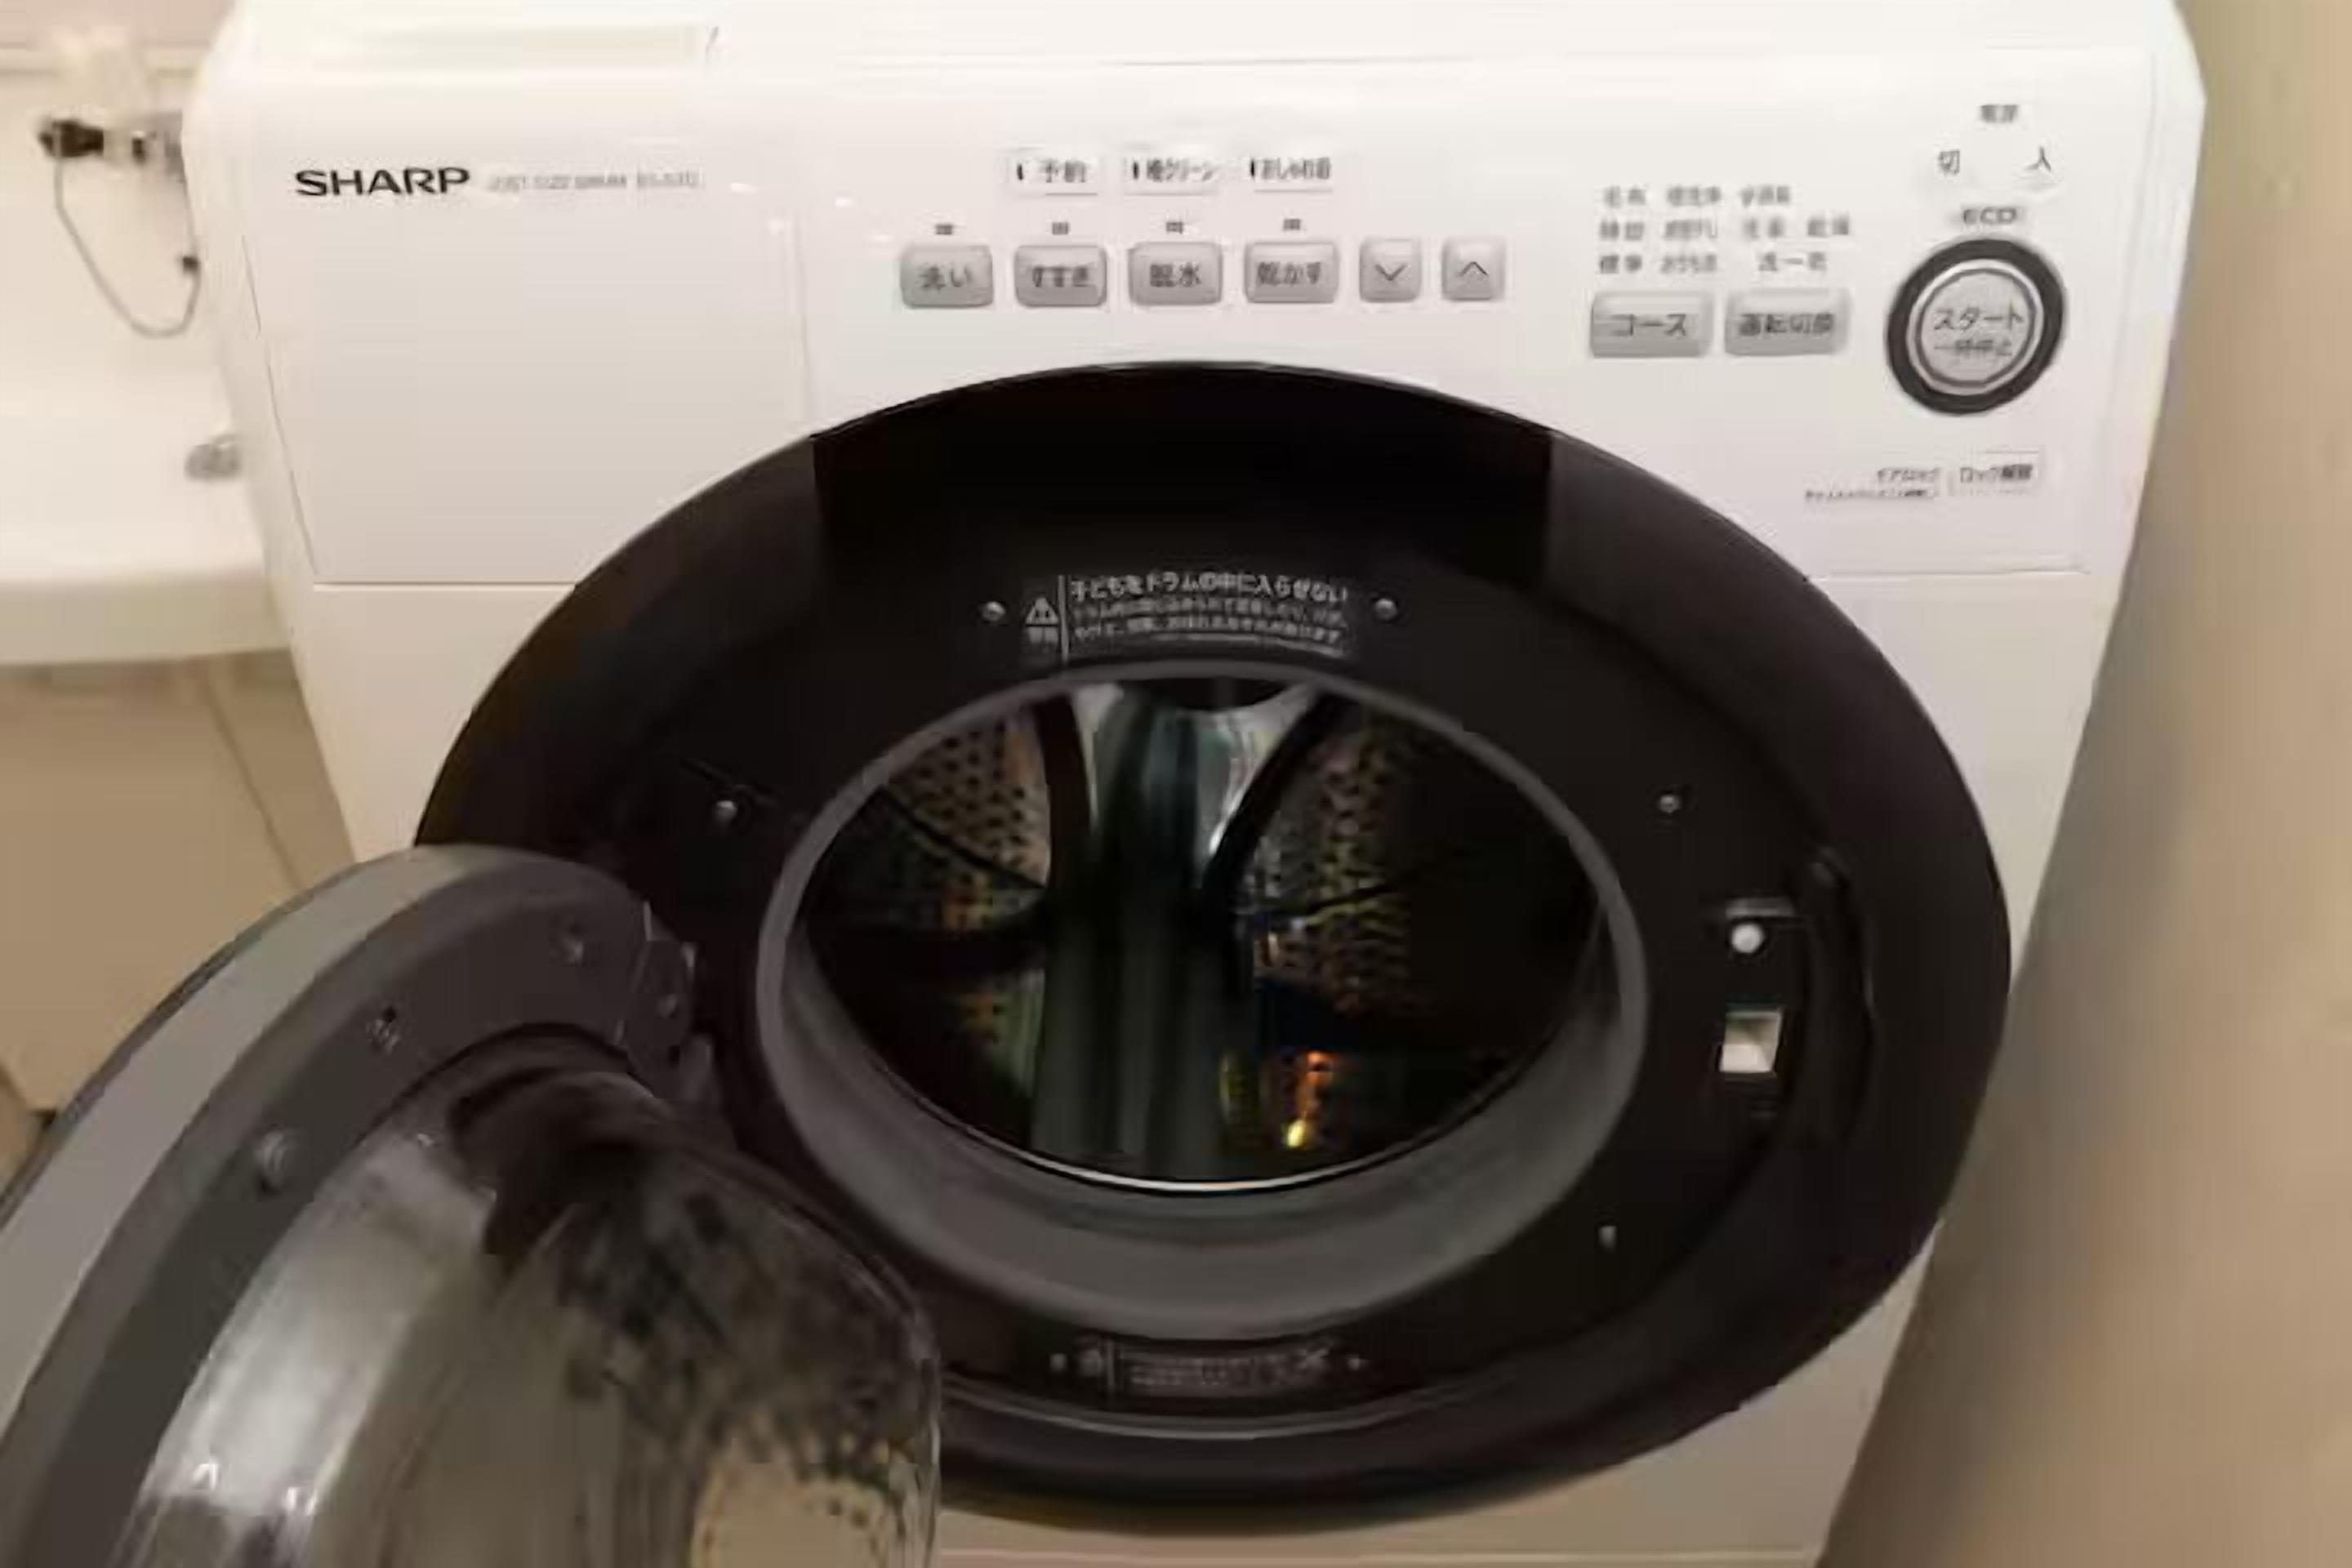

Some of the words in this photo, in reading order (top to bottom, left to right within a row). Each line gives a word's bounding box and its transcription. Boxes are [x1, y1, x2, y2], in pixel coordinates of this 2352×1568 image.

[1938, 149, 1961, 176] 切
[2024, 145, 2052, 172] 入
[295, 167, 470, 197] SHARP
[1149, 262, 1202, 287] 脱水
[1258, 261, 1322, 286] 乾かす
[1610, 313, 1687, 337] コース
[1933, 301, 2023, 330] スタート
